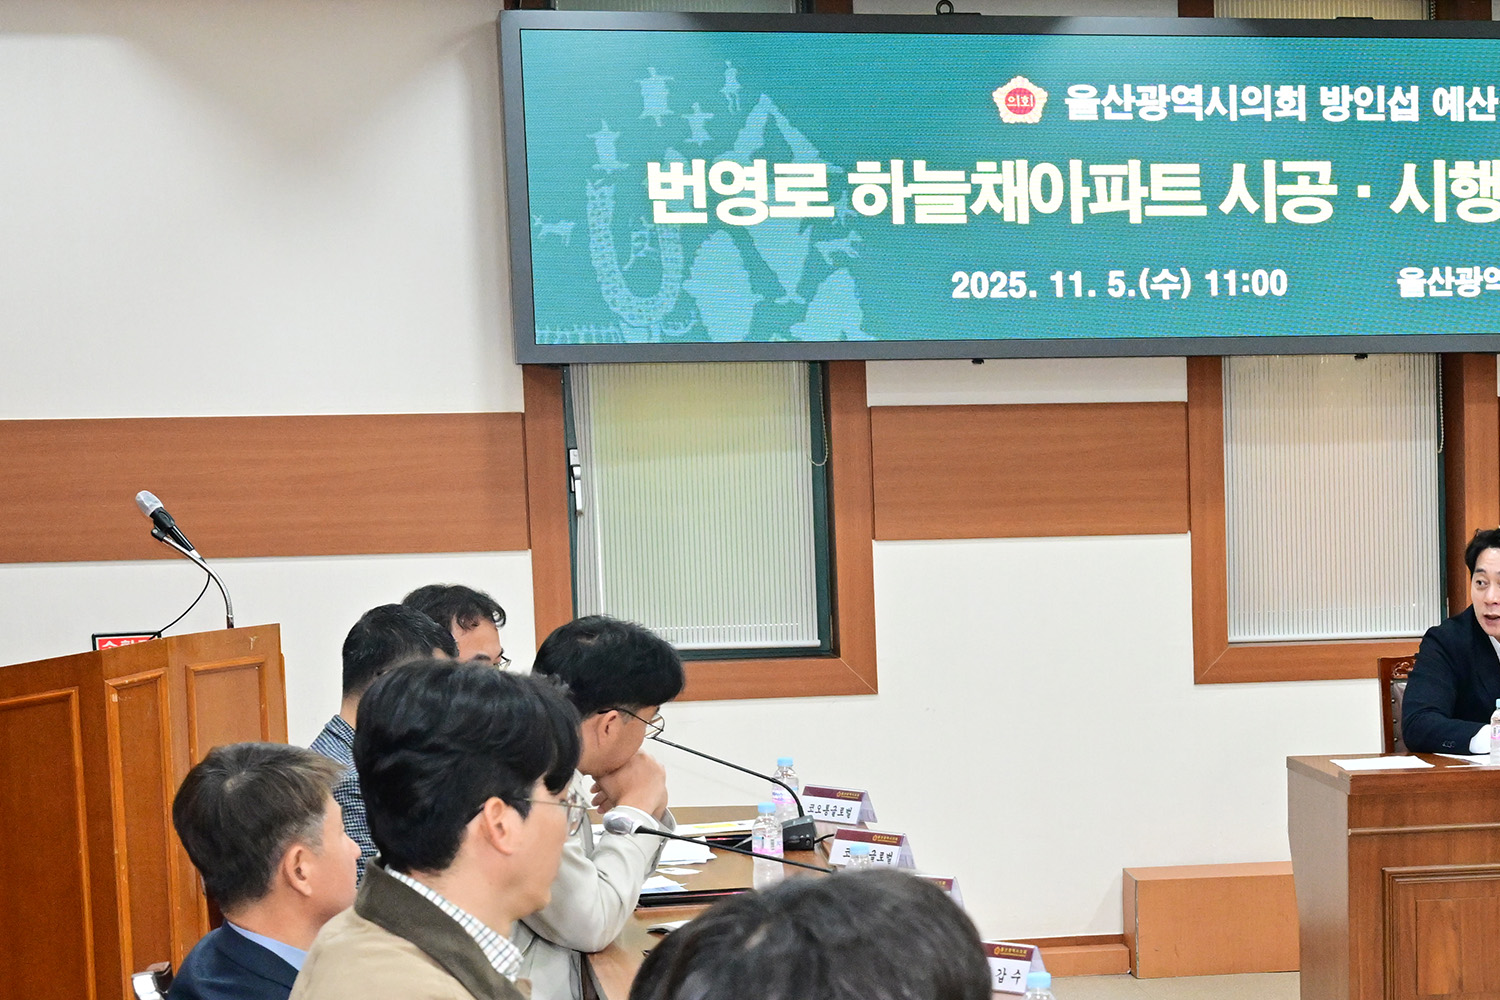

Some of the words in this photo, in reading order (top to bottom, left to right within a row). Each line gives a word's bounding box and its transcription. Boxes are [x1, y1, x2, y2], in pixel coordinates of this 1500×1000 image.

[1006, 93, 1035, 108] 의회
[1064, 83, 1306, 122] 울산광역시의회
[1320, 85, 1420, 122] 방인섭
[647, 158, 835, 226] 번영로
[847, 159, 1208, 225] 하늘채아파트
[1218, 159, 1338, 224] 시공
[951, 270, 1037, 299] 2025.
[1050, 270, 1096, 298] 11.
[1107, 267, 1191, 300] 5.(수)
[1204, 268, 1288, 297] 11:00
[807, 803, 853, 819] 코오롱글로벌
[843, 847, 894, 864] 코글로벌
